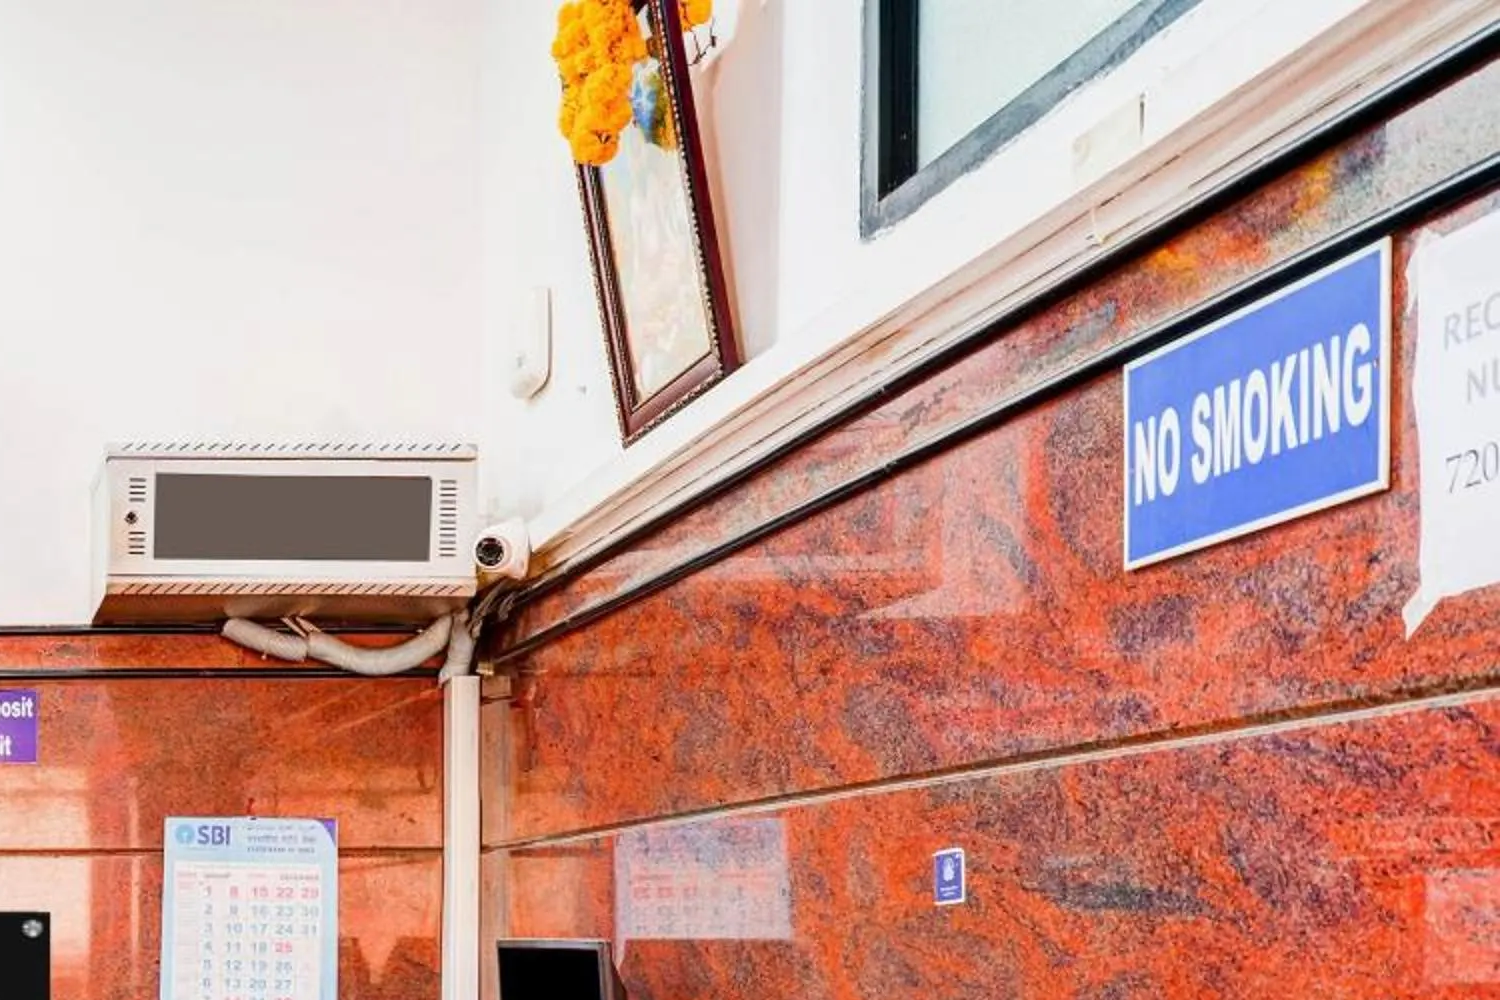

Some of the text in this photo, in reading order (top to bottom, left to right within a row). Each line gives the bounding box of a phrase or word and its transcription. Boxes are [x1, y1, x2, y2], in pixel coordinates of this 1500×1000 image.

[1134, 322, 1373, 507] NO SMOKING
[197, 825, 231, 845] SBI
